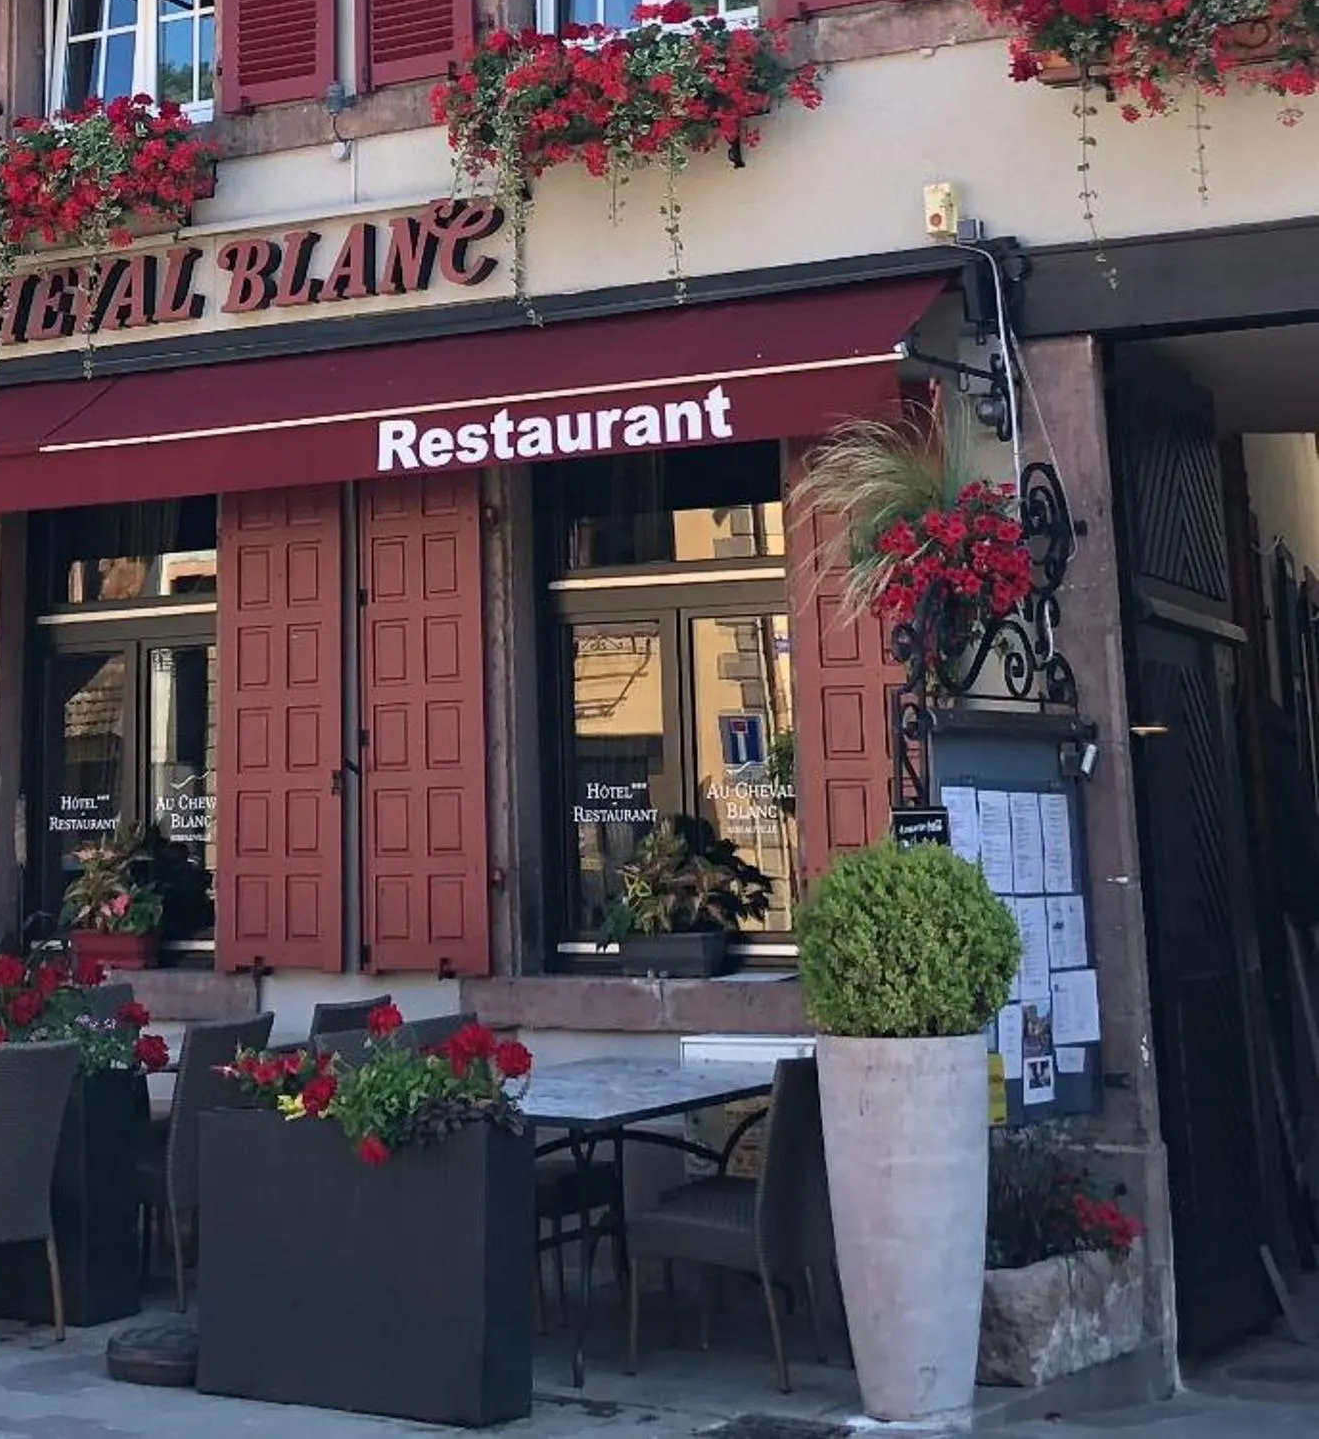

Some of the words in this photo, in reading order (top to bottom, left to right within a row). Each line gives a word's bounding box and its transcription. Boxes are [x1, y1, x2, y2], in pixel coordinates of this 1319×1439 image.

[218, 198, 501, 314] BLANC
[377, 385, 733, 471] Restaurant
[706, 783, 730, 800] AU
[735, 781, 795, 800] CHEVAL
[155, 797, 175, 811] AU
[177, 793, 217, 811] CHEV
[726, 802, 778, 819] BLANC
[170, 813, 212, 830] BLANC
[573, 805, 658, 823] RESTAURANT
[49, 816, 117, 831] RESTAURANT
